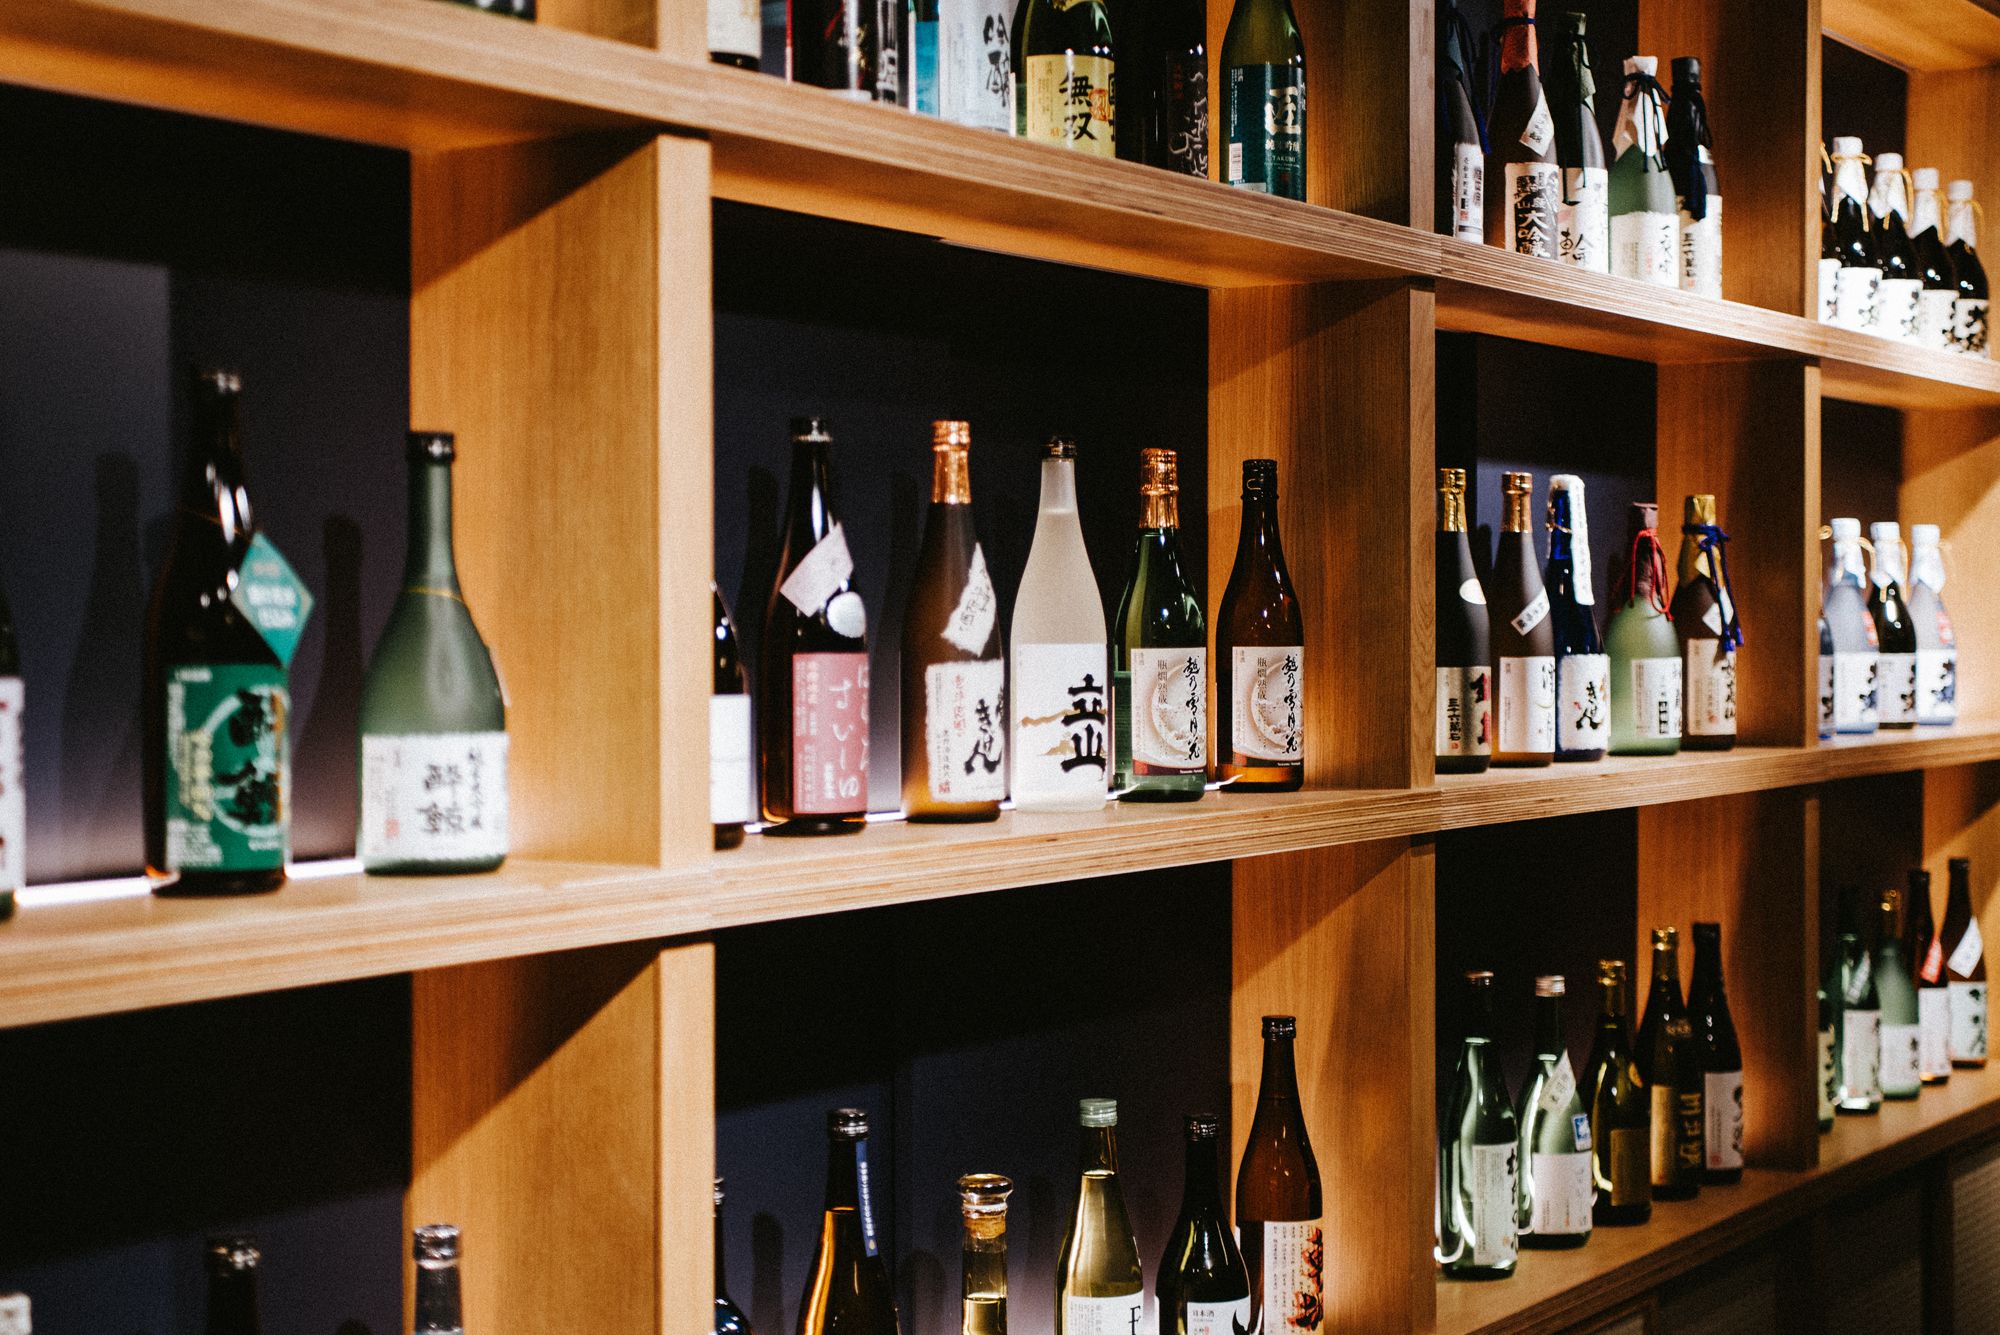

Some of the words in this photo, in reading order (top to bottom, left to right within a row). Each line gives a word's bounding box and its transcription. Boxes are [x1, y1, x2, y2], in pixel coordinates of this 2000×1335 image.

[1059, 72, 1097, 140] 無双
[1264, 86, 1301, 135] 匠
[1061, 674, 1106, 777] 立山
[1183, 656, 1200, 760] 越乃雪月花
[1282, 654, 1298, 753] 越乃雪月花
